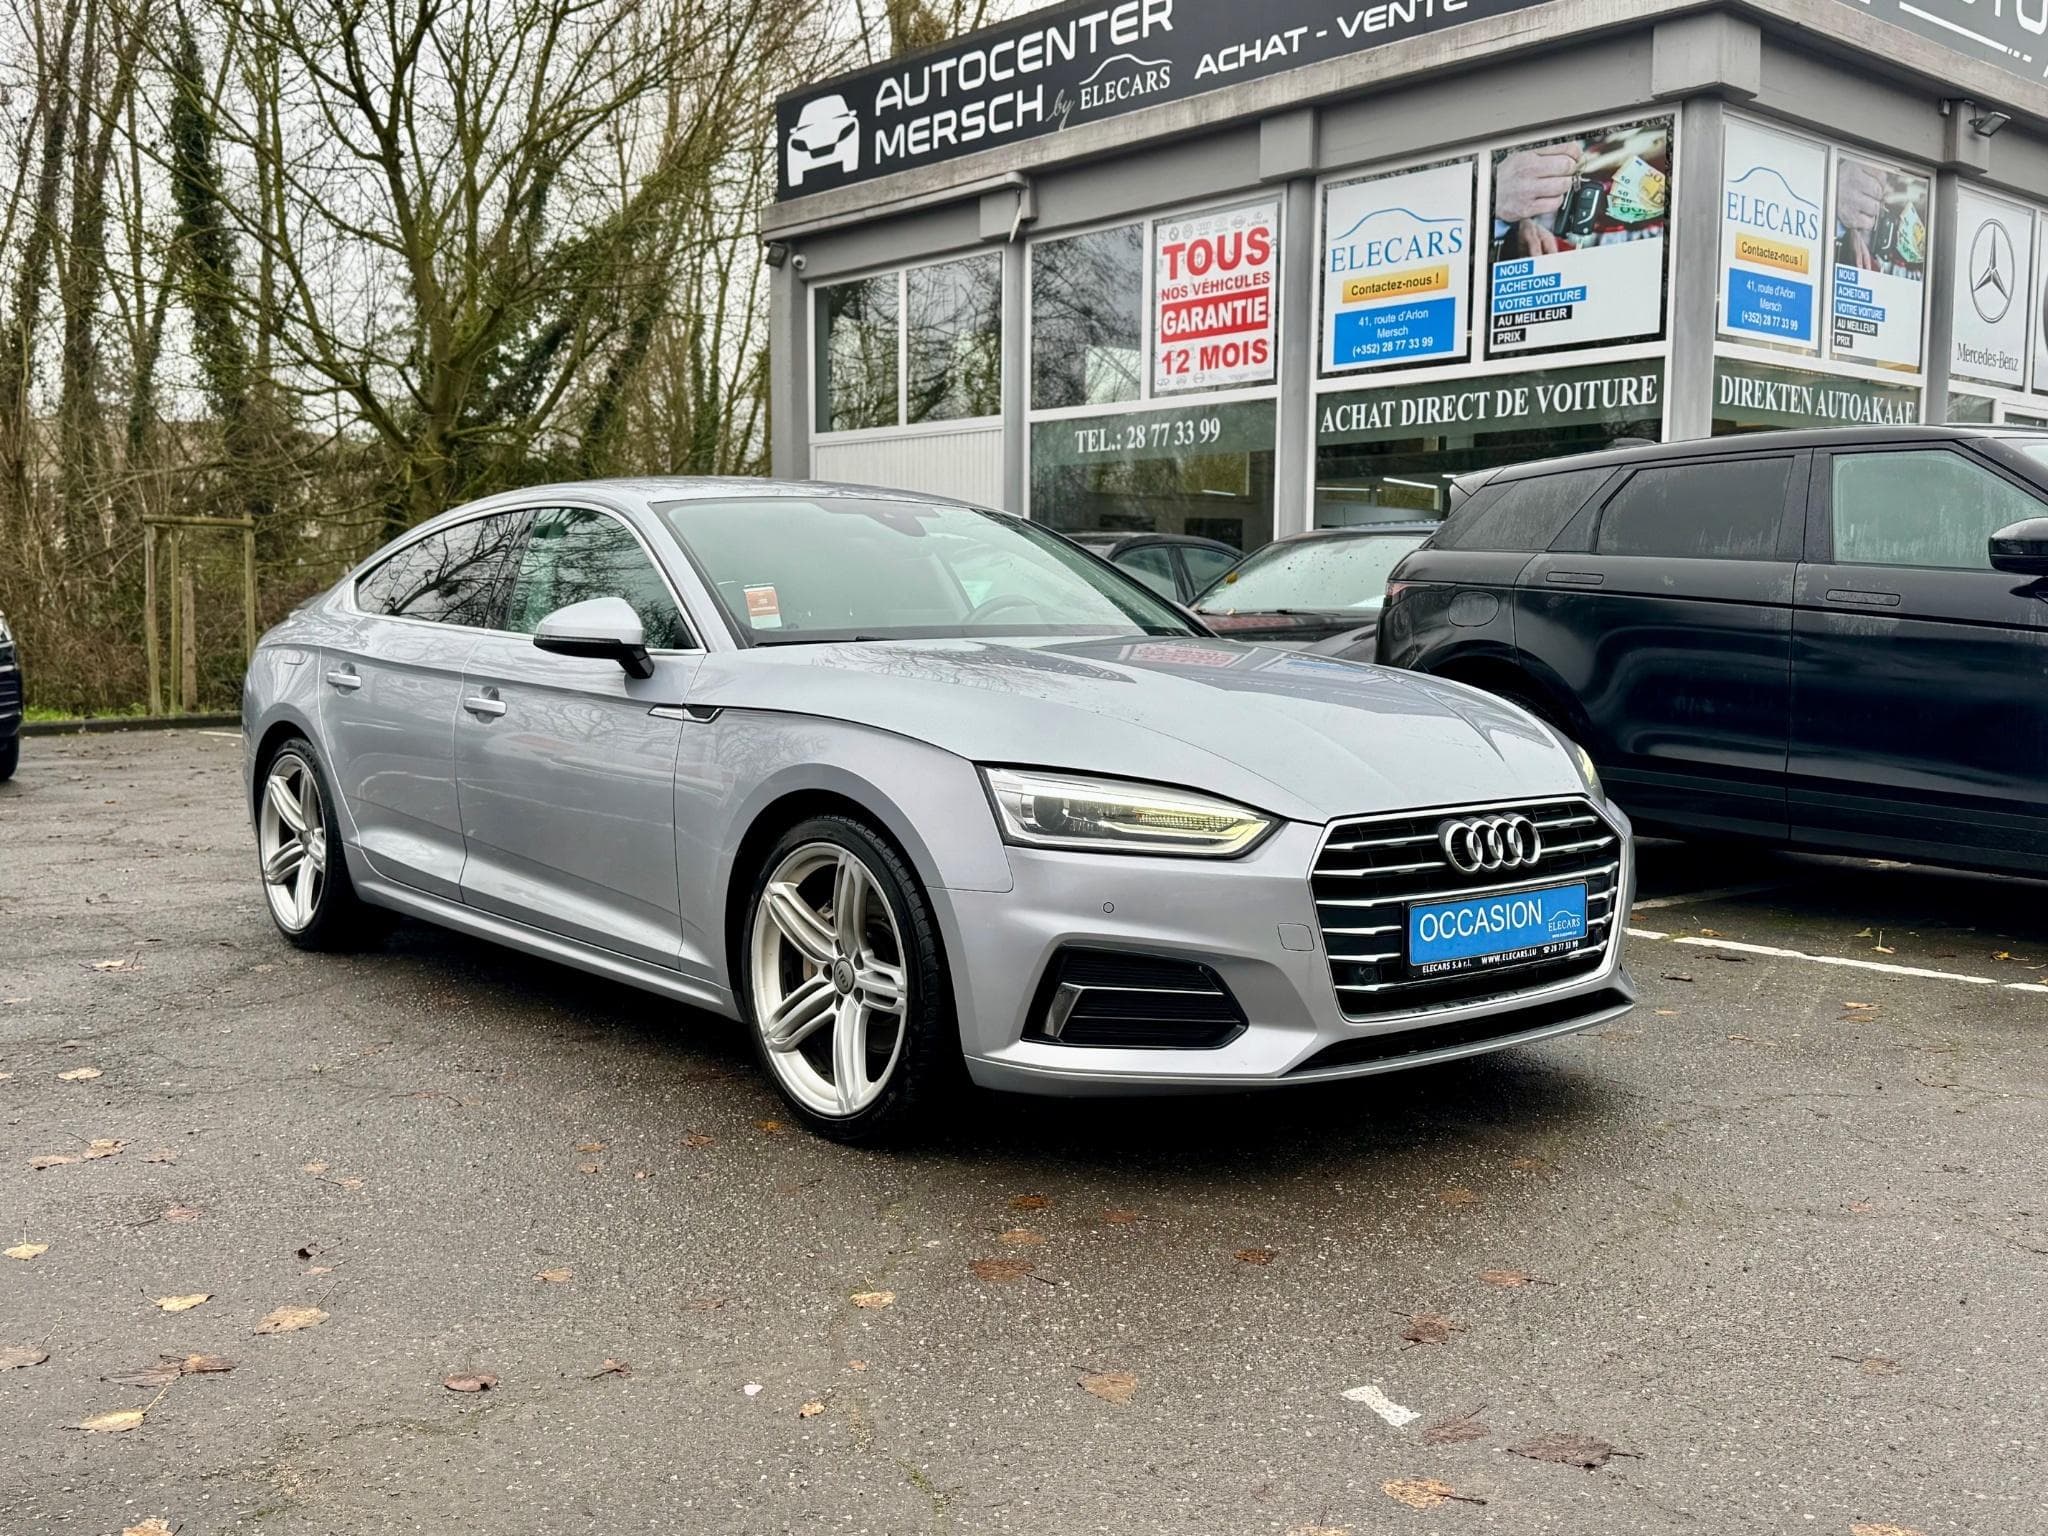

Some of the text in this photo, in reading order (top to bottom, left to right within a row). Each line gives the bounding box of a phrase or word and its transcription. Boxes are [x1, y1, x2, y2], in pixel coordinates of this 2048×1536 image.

[875, 0, 1174, 117] AUTOCENTER
[1194, 26, 1308, 80] ACHAT
[874, 65, 1172, 164] MERSCH by ELECARS
[1727, 191, 1819, 241] ELECARS
[1162, 227, 1271, 280] TOUS
[1330, 226, 1463, 273] ELECARS
[1741, 241, 1799, 265] Contactez-nous
[1500, 263, 1529, 277] NOUS
[1838, 268, 1856, 281] NOUS
[1161, 285, 1188, 301] NOS
[1351, 276, 1432, 296] Contactez-nous
[1498, 276, 1556, 294] ACHETONS
[1838, 286, 1870, 301] ACHETONS
[1498, 289, 1582, 310] VOTRE VOITURE
[1163, 295, 1267, 336] GARANTIE
[1358, 316, 1372, 327] 41,
[1374, 313, 1396, 325] route
[1497, 307, 1567, 327] AU MEILLEUR
[1836, 318, 1846, 329] AU
[1376, 325, 1409, 338] Mersch
[1497, 331, 1521, 344] PRIX
[1836, 334, 1851, 346] PRIX
[1161, 338, 1268, 375] 12 MOIS
[1352, 336, 1434, 358] (+352) 28 77 33 99
[1957, 342, 2019, 372] Mercedes-Benz
[1320, 374, 1657, 433] ACHAT DIRECT DE VOITURE
[1719, 375, 1813, 416] DIREKTEN
[1075, 417, 1221, 454] TEL.: 28 77 33 99
[1419, 899, 1542, 942] OCCASION
[1548, 918, 1581, 932] ELECARS
[1422, 962, 1451, 974] ELECARS
[1481, 948, 1537, 965] WWW.ELECARS.LU
